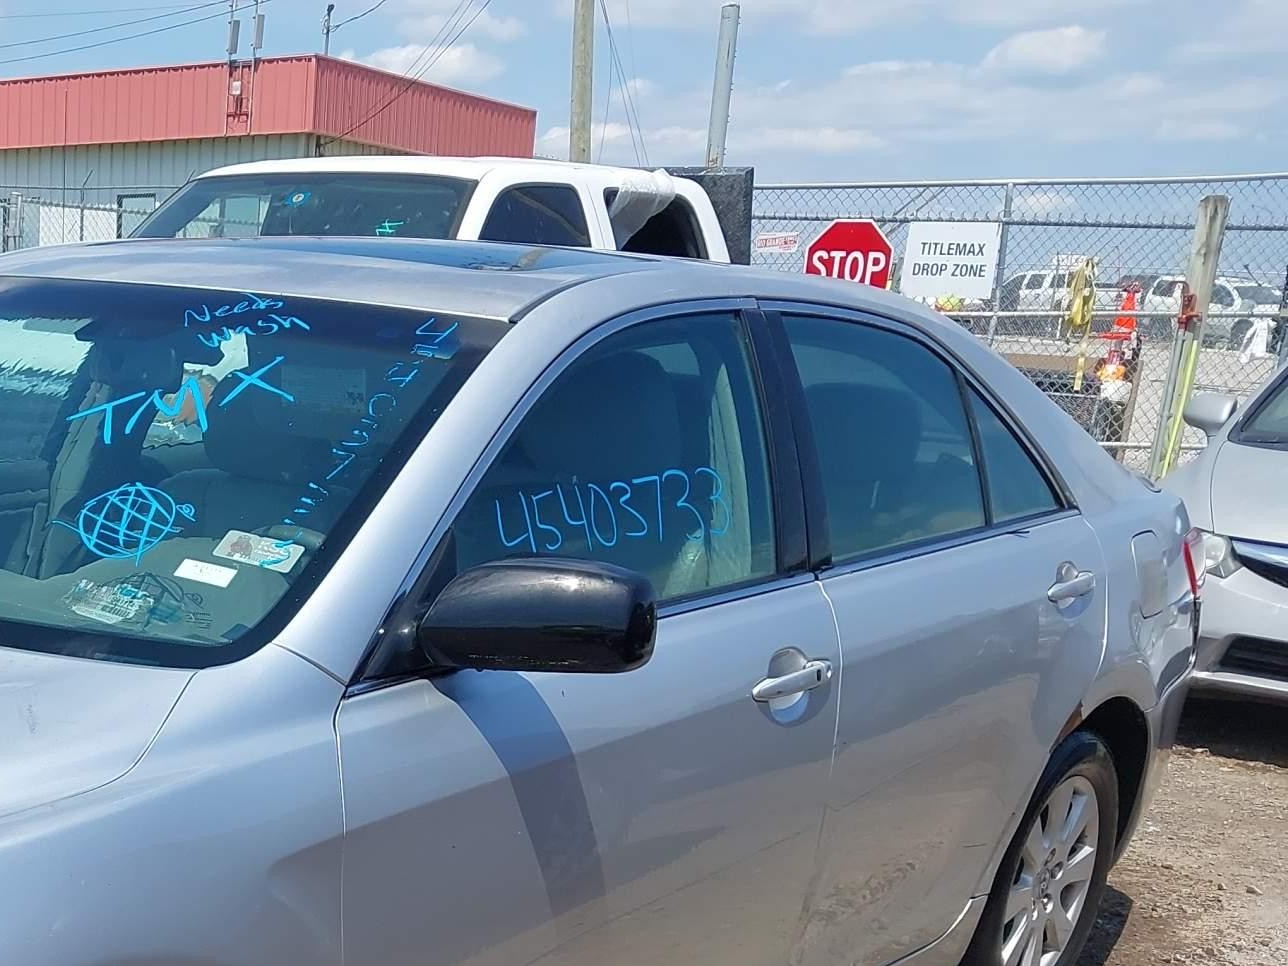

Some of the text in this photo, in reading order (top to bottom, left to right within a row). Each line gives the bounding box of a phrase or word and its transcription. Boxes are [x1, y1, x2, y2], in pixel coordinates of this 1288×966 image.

[920, 242, 986, 257] TITLEMAX
[812, 250, 886, 286] STOP
[912, 263, 987, 278] DROP ZONE
[184, 292, 284, 328] Needs
[66, 355, 295, 444] TMX
[496, 466, 730, 553] 45403733
